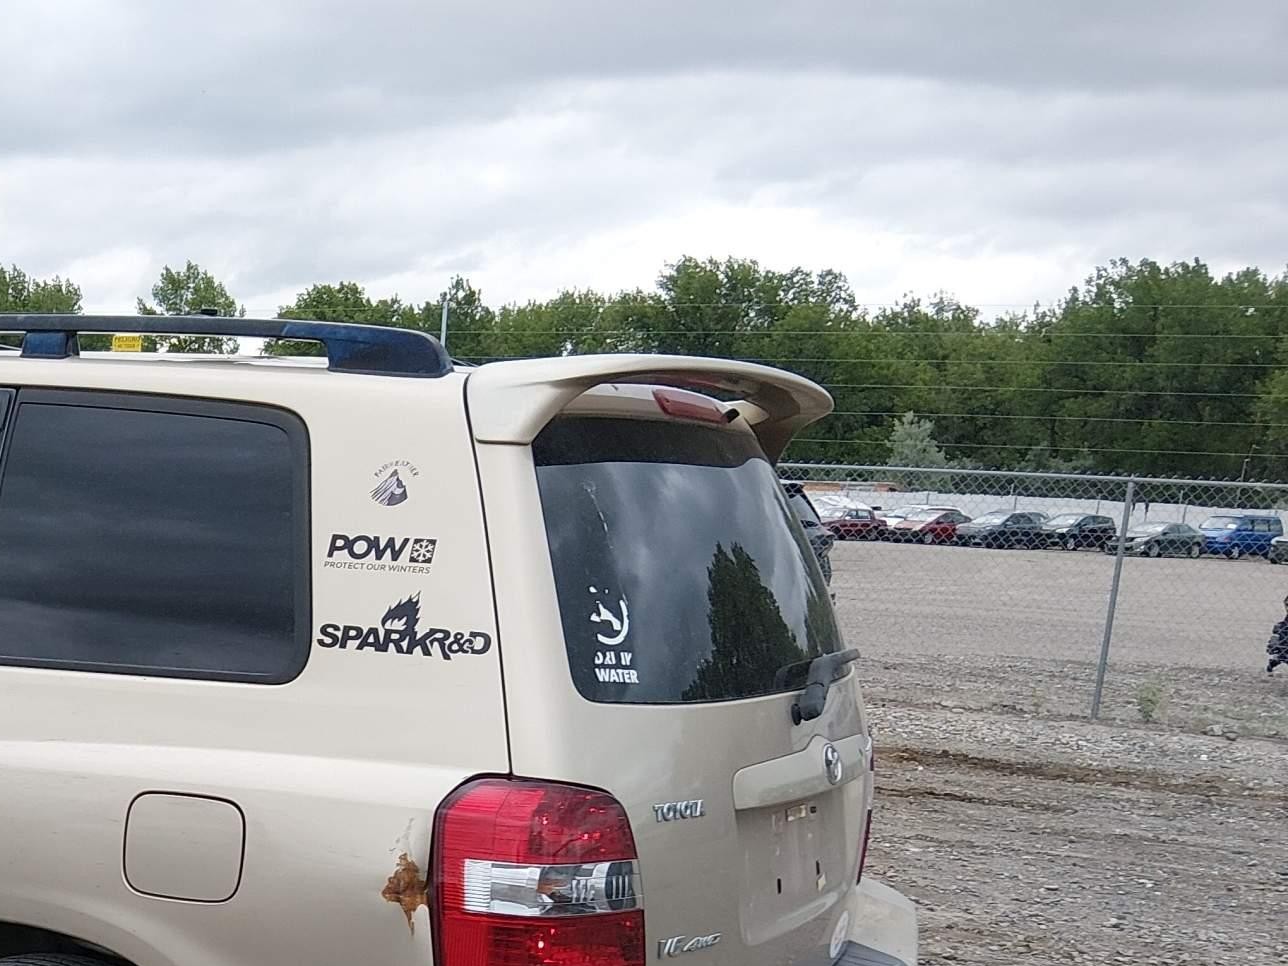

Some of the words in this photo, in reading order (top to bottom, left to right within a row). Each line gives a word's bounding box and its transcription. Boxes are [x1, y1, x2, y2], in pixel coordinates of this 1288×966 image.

[327, 534, 410, 562] POW
[324, 561, 365, 571] PROTECT
[366, 563, 386, 571] OUR
[388, 564, 431, 574] WINTERS
[594, 668, 640, 683] WATER
